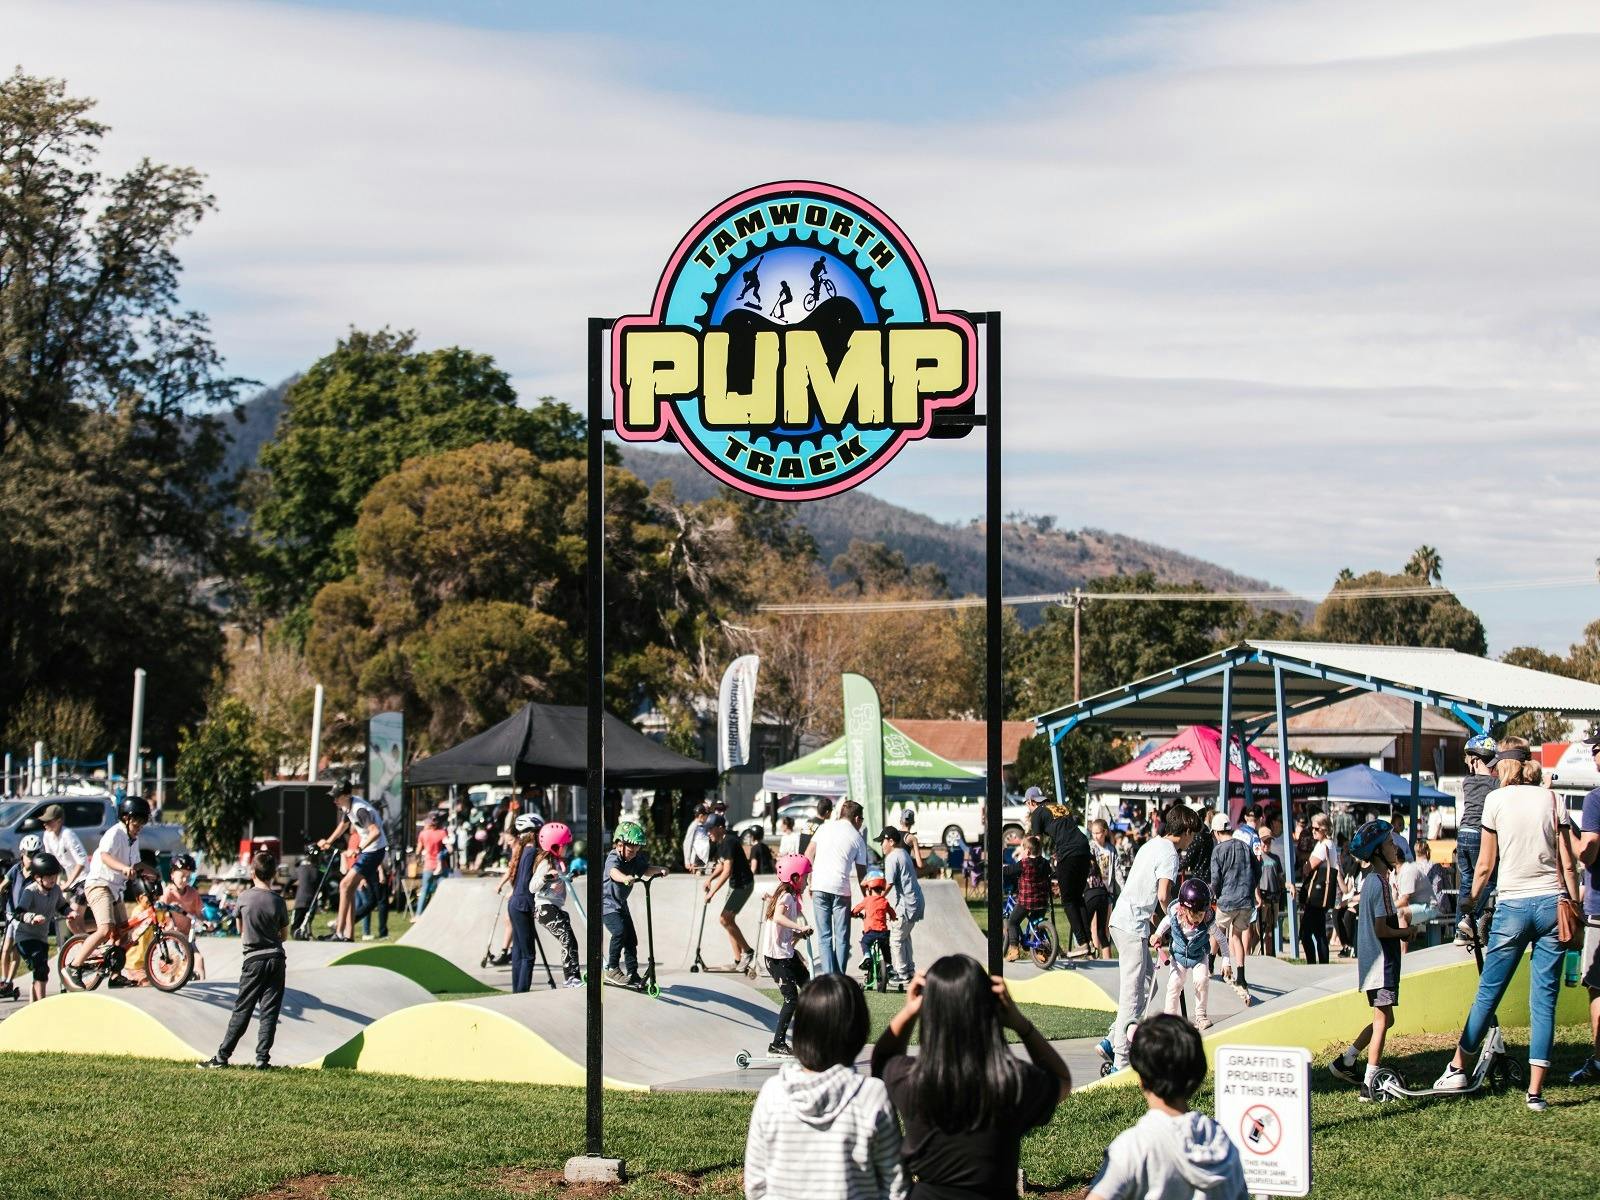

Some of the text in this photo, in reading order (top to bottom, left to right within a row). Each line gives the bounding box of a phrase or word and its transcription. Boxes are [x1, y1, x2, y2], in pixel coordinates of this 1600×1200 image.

[694, 203, 895, 269] TAMWORTH
[626, 328, 963, 425] PUMP
[724, 434, 868, 479] TRACK
[1228, 1055, 1279, 1068] GRAFFITI
[1224, 1084, 1298, 1098] AT THIS PARK
[1227, 1070, 1294, 1083] PROHIBITED
